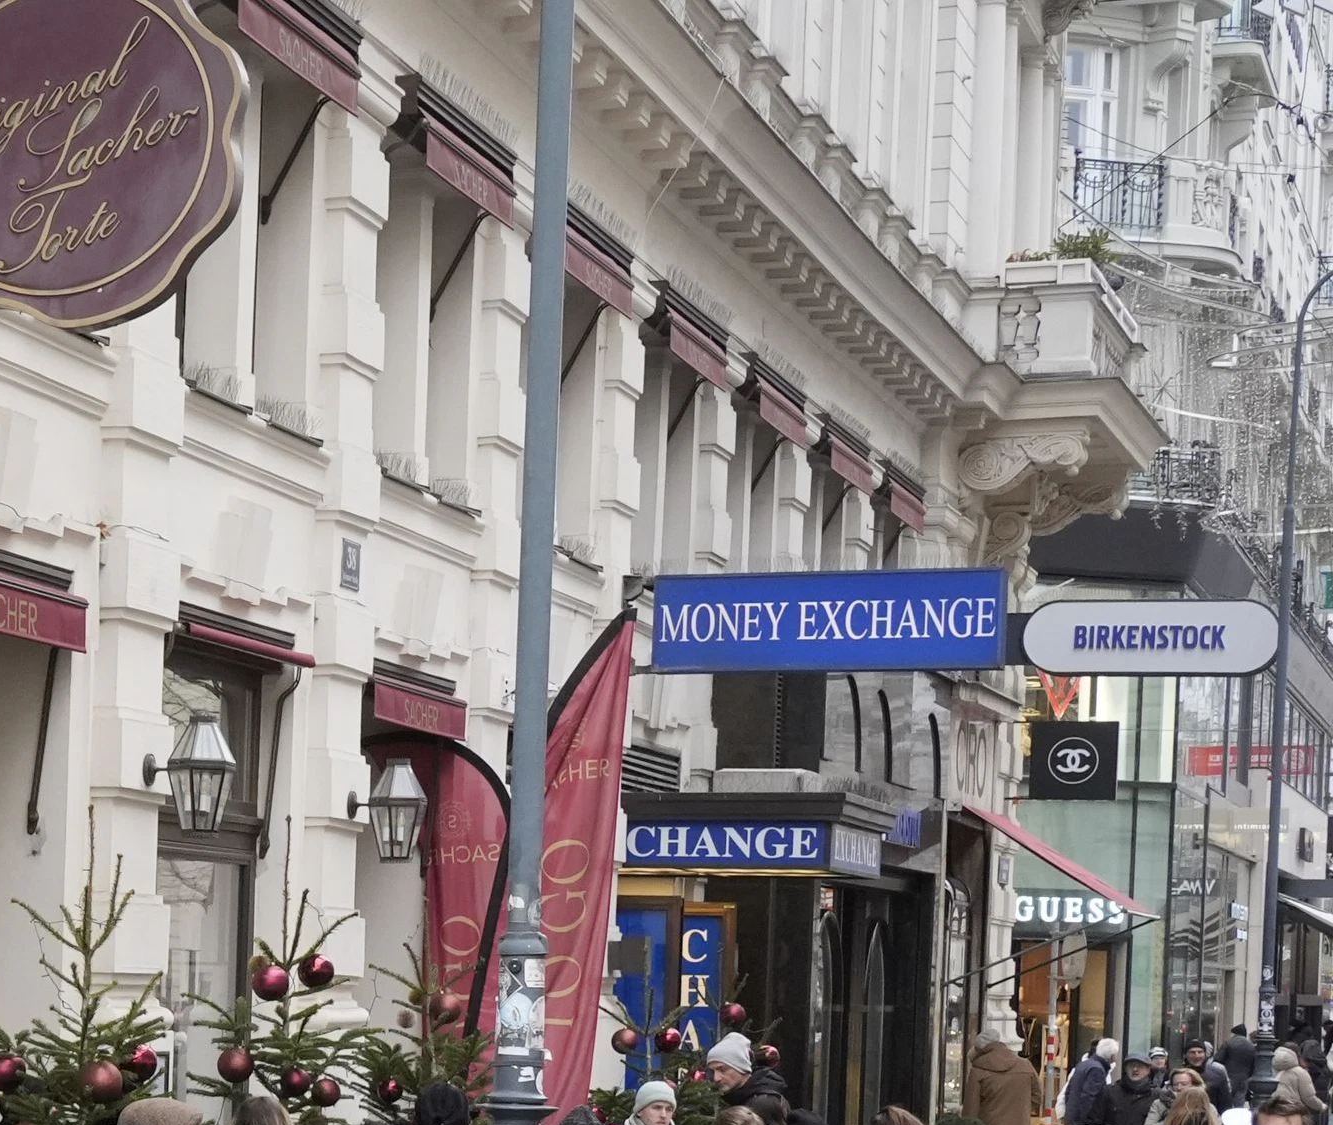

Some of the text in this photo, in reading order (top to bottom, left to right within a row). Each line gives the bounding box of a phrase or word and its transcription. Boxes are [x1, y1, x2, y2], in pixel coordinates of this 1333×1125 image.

[17, 85, 200, 191] Sacher
[346, 546, 357, 571] 38
[659, 597, 997, 643] MONEY EXCHANGE
[1073, 625, 1226, 651] BIRKENSTOCK
[404, 697, 439, 732] SACHER
[544, 758, 611, 793] CHER
[956, 719, 987, 799] CIRO
[626, 825, 819, 860] CHANGE
[834, 829, 878, 868] EXCHANGE
[1015, 895, 1125, 925] GUESS
